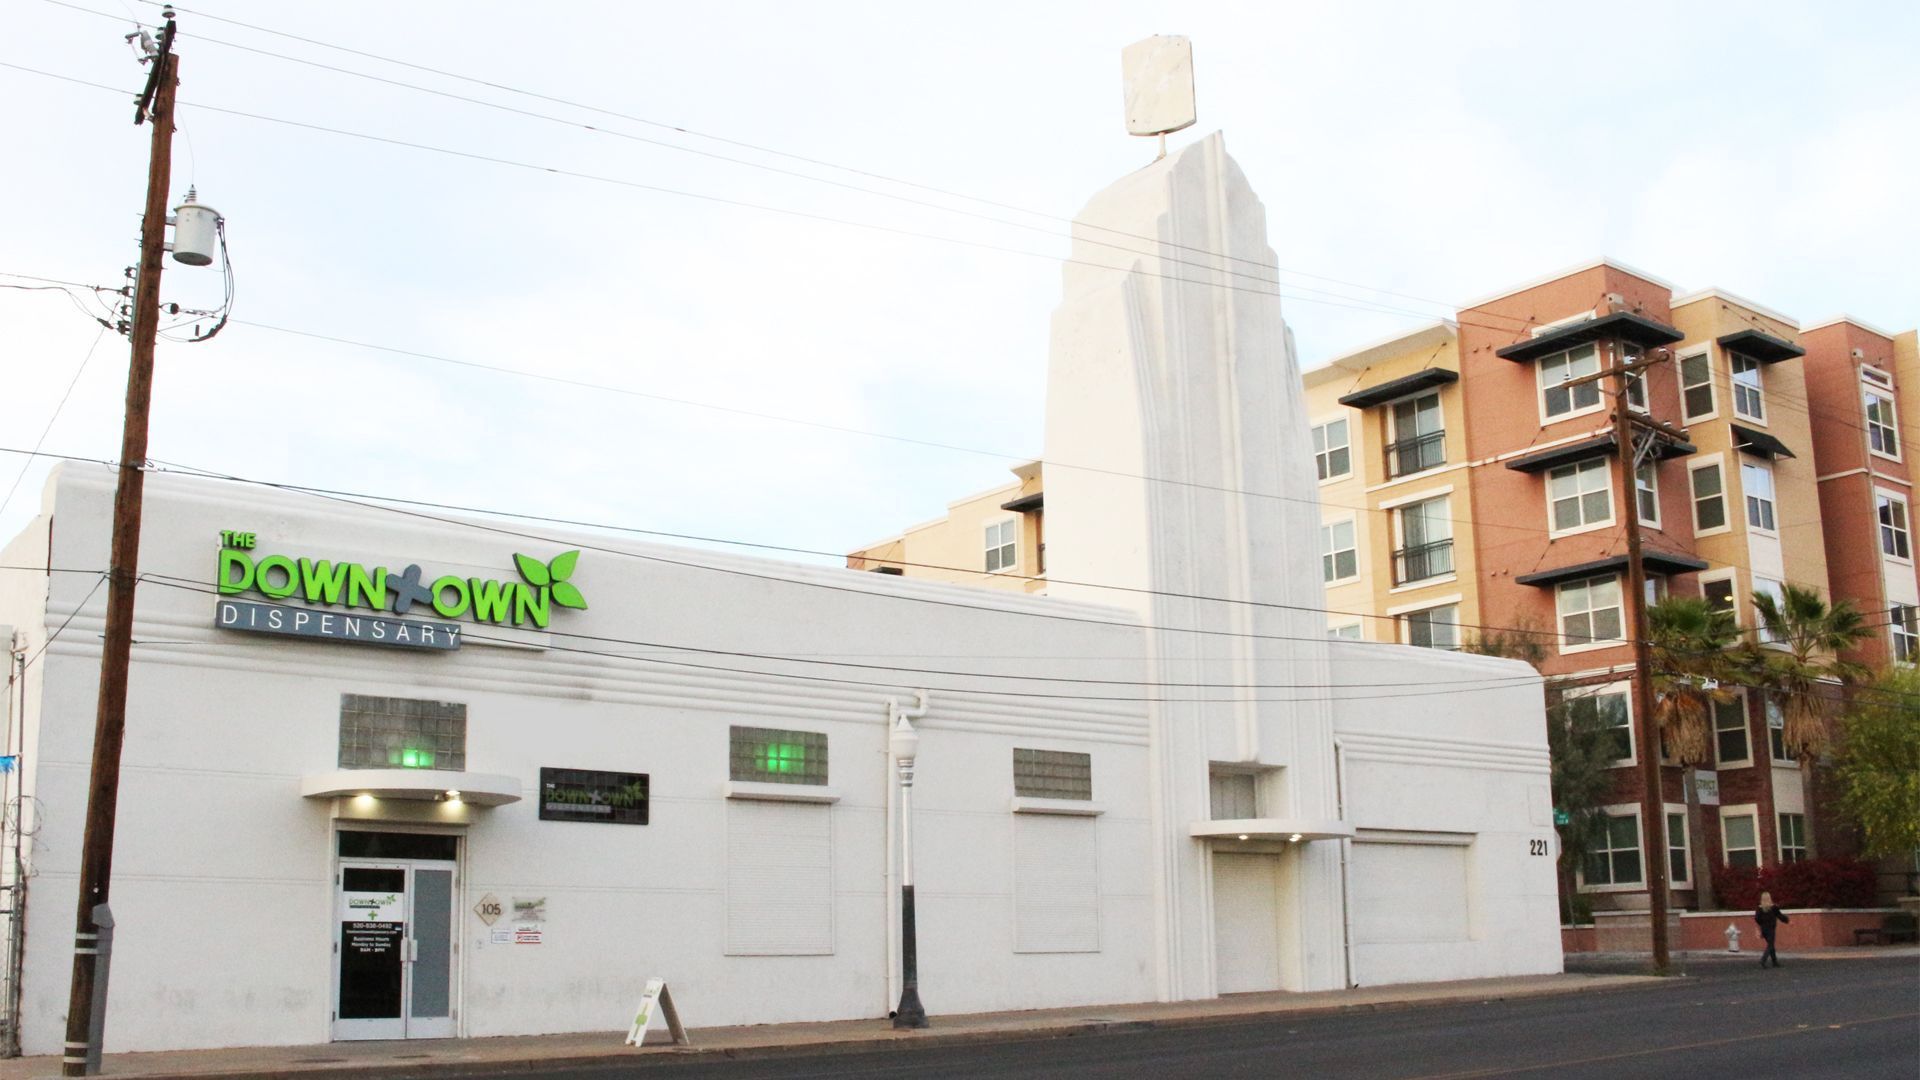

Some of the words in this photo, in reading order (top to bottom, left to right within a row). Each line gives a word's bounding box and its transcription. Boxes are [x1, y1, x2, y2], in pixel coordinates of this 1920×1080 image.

[221, 530, 256, 549] THE
[222, 605, 461, 648] DISPENSARY
[1530, 839, 1548, 856] 221
[482, 903, 502, 916] 105
